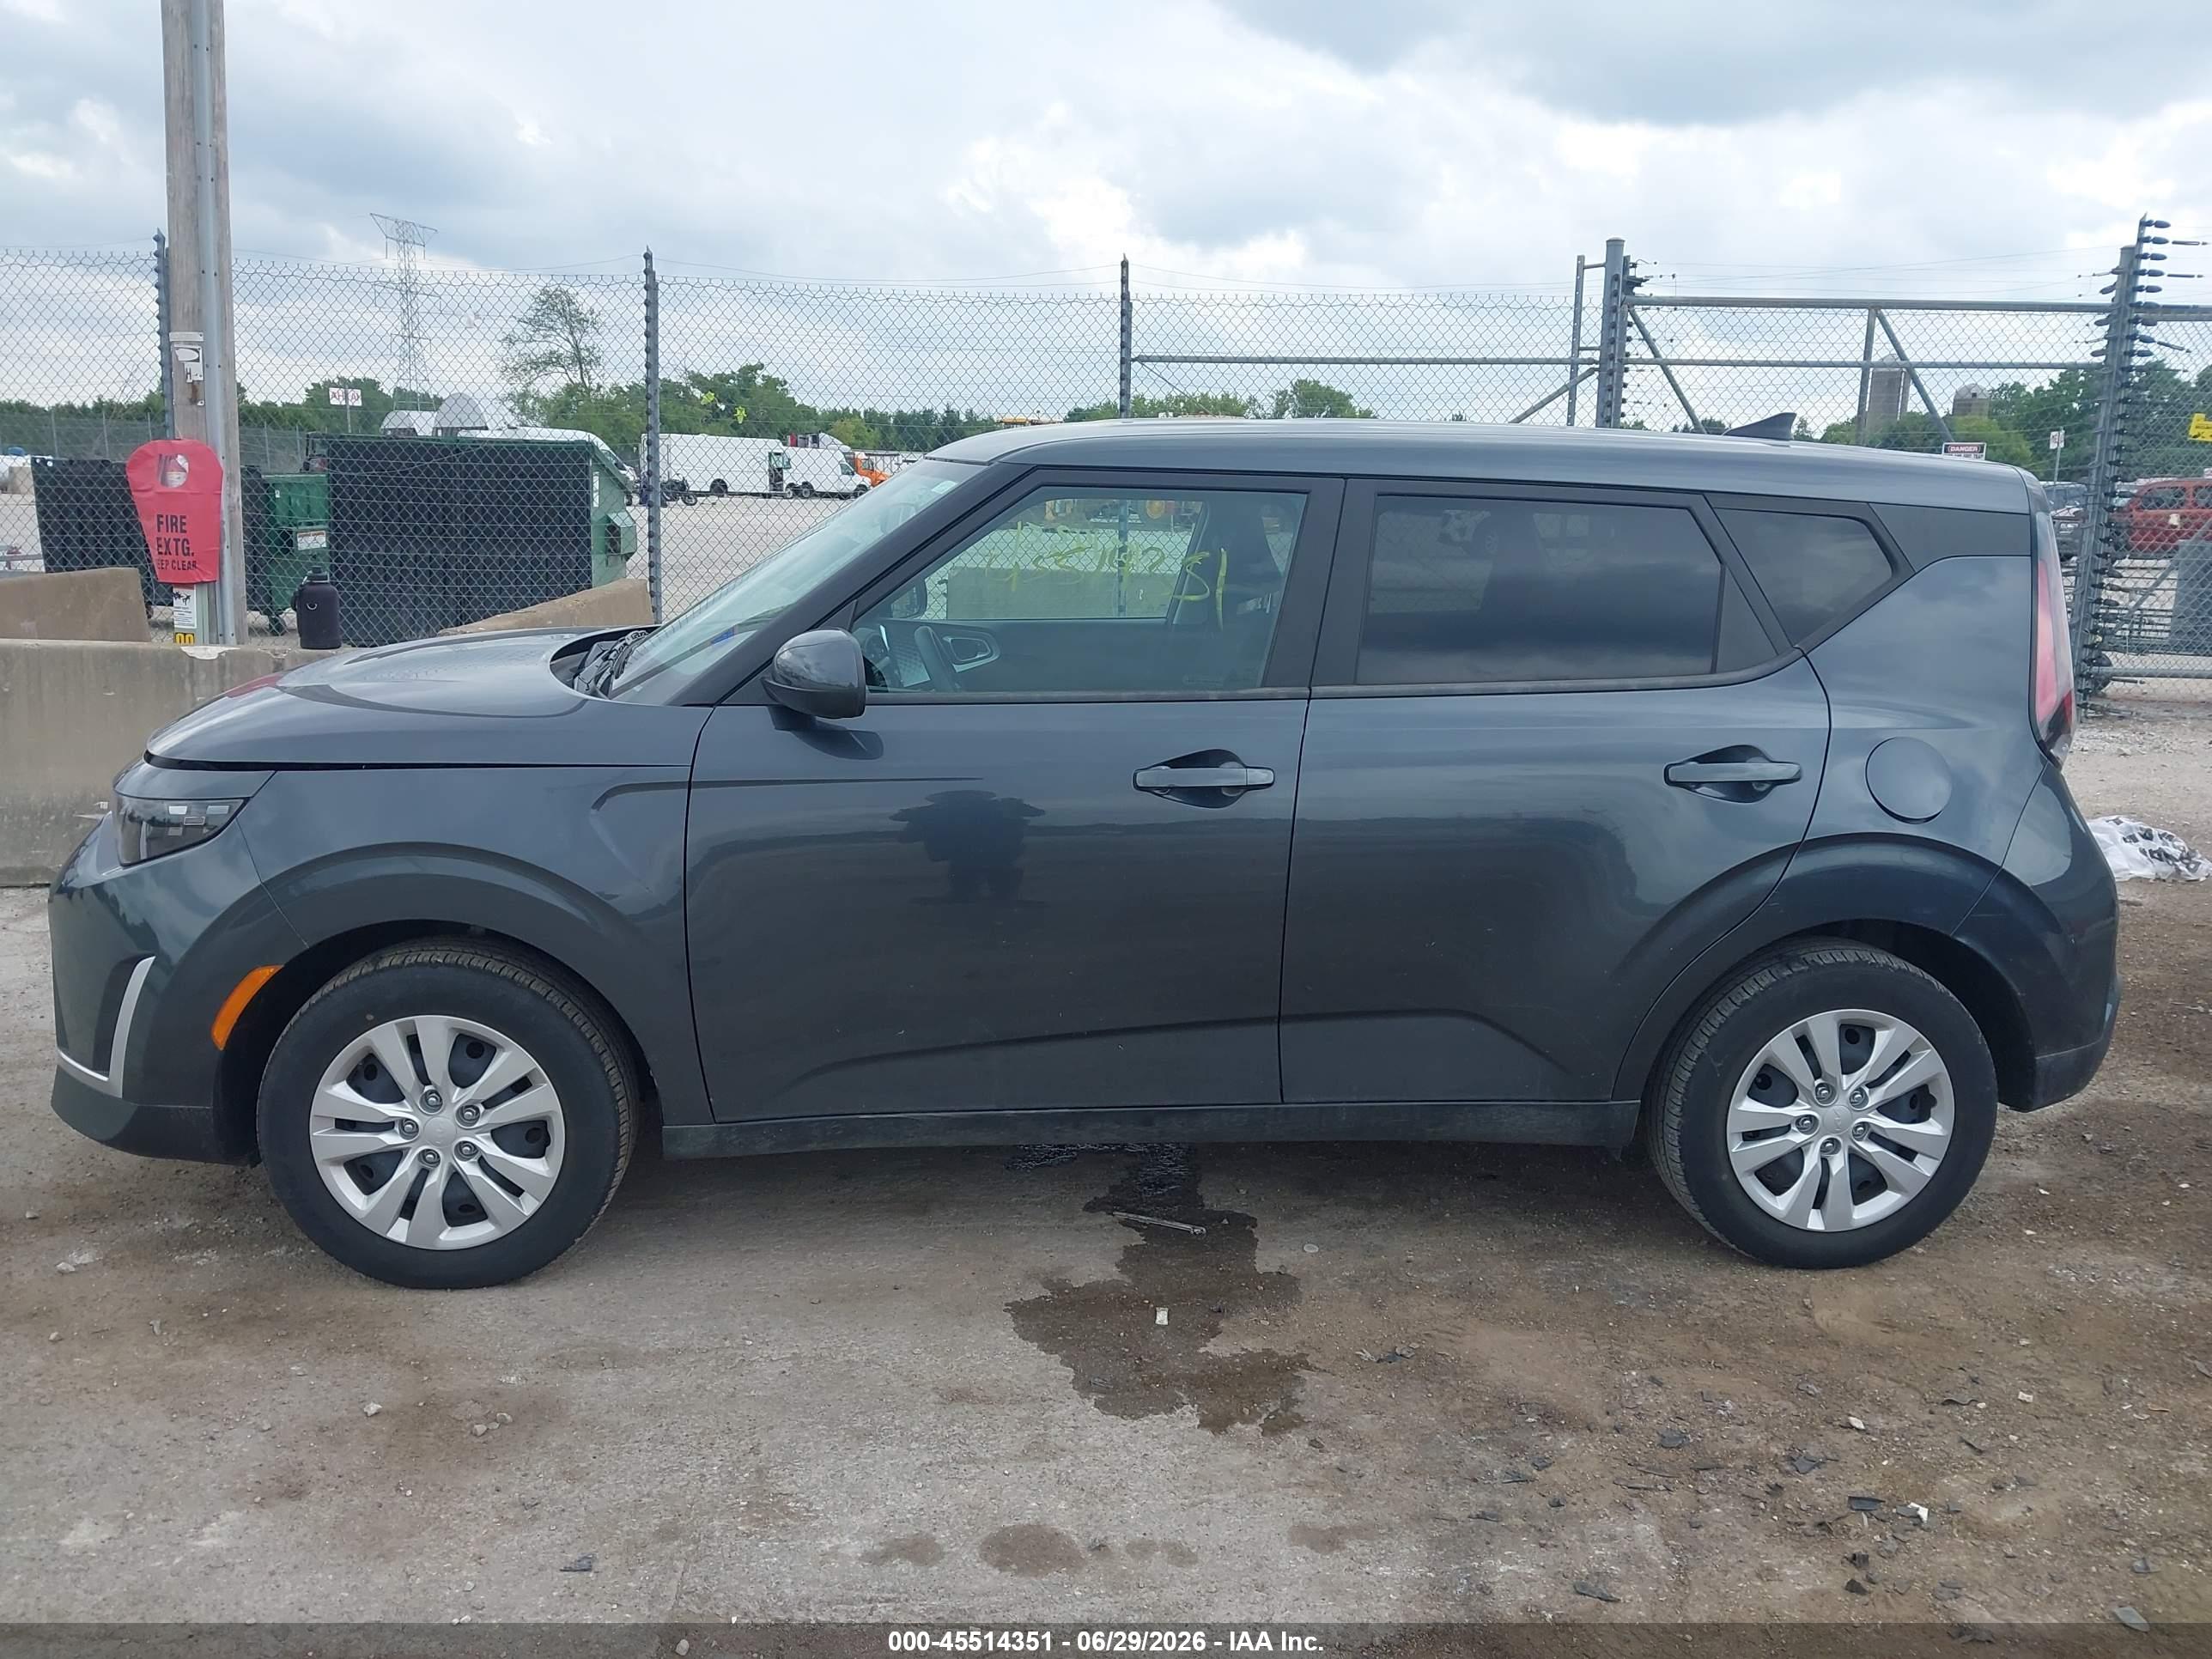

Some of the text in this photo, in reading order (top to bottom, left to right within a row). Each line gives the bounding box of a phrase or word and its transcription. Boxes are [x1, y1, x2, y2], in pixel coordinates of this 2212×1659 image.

[156, 514, 187, 533] FIRE
[156, 537, 195, 557] EXTG.
[171, 560, 198, 571] CLEAR
